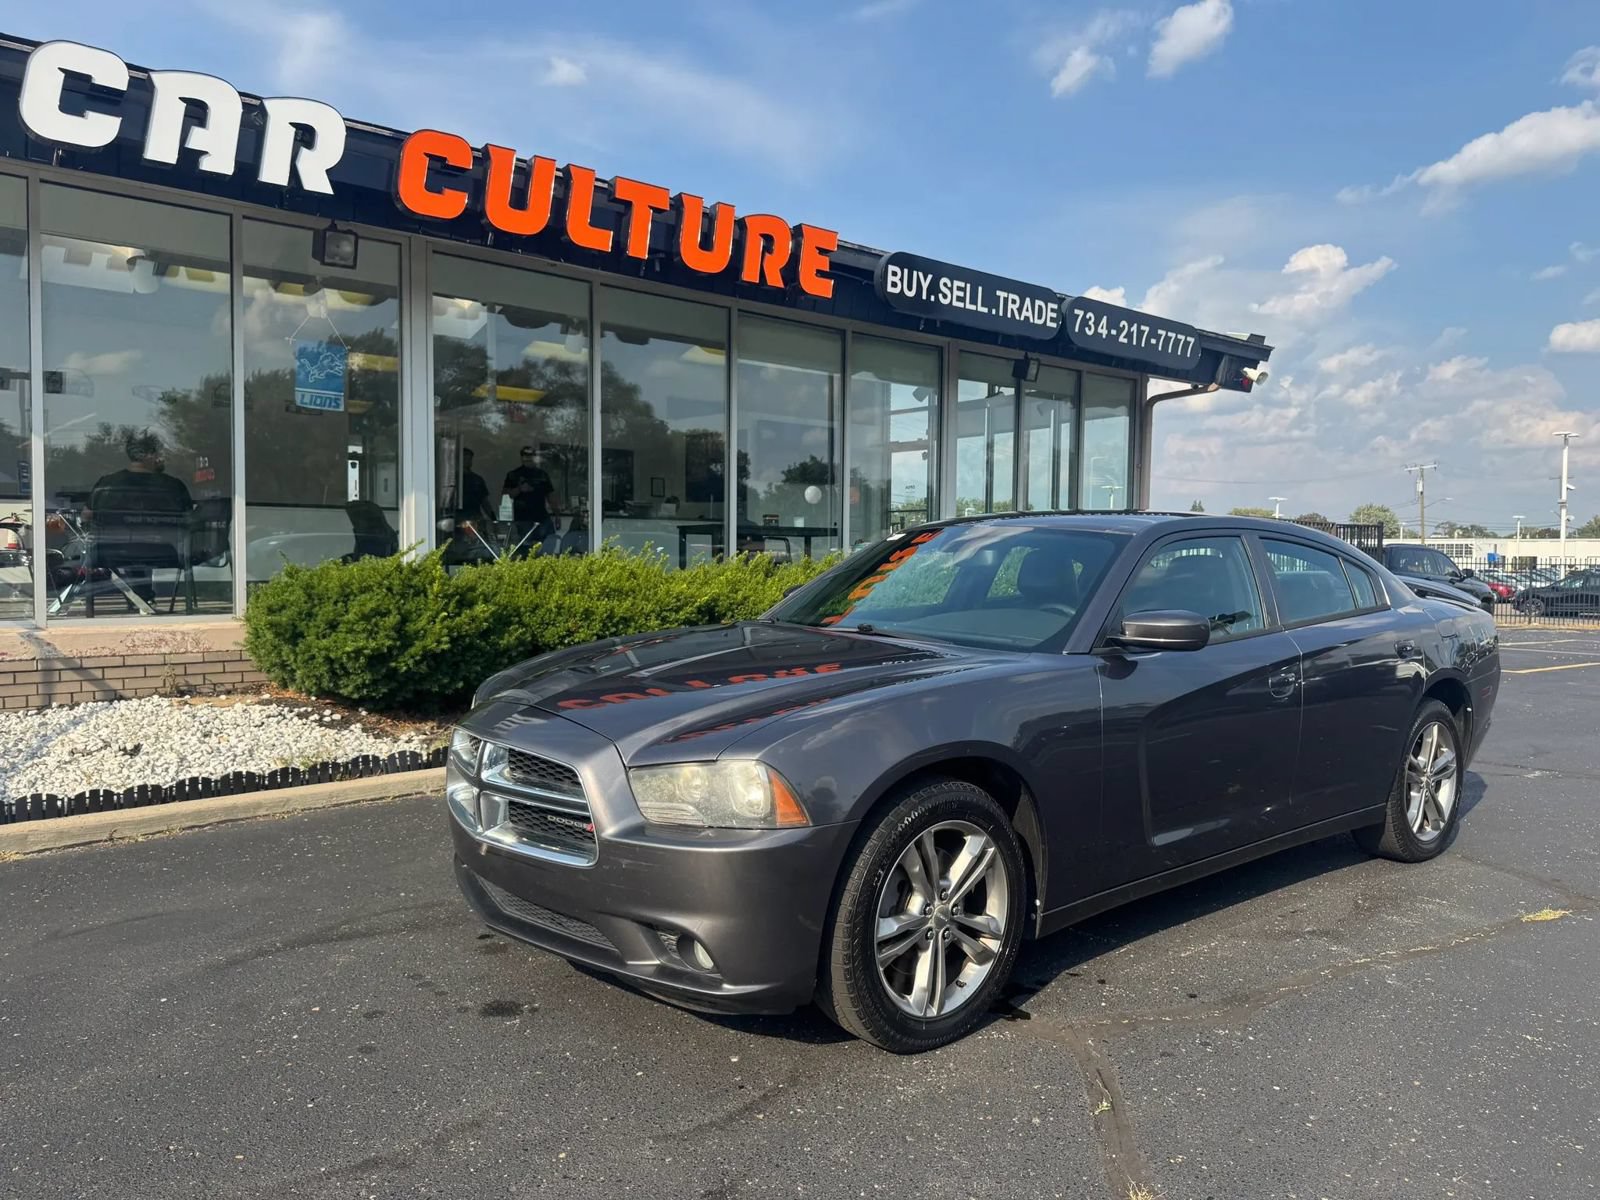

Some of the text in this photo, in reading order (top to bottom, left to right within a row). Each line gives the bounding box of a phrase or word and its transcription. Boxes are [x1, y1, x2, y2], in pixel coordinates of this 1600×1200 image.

[19, 40, 839, 299] CAR CULTURE
[1073, 308, 1196, 358] 734-217-7777
